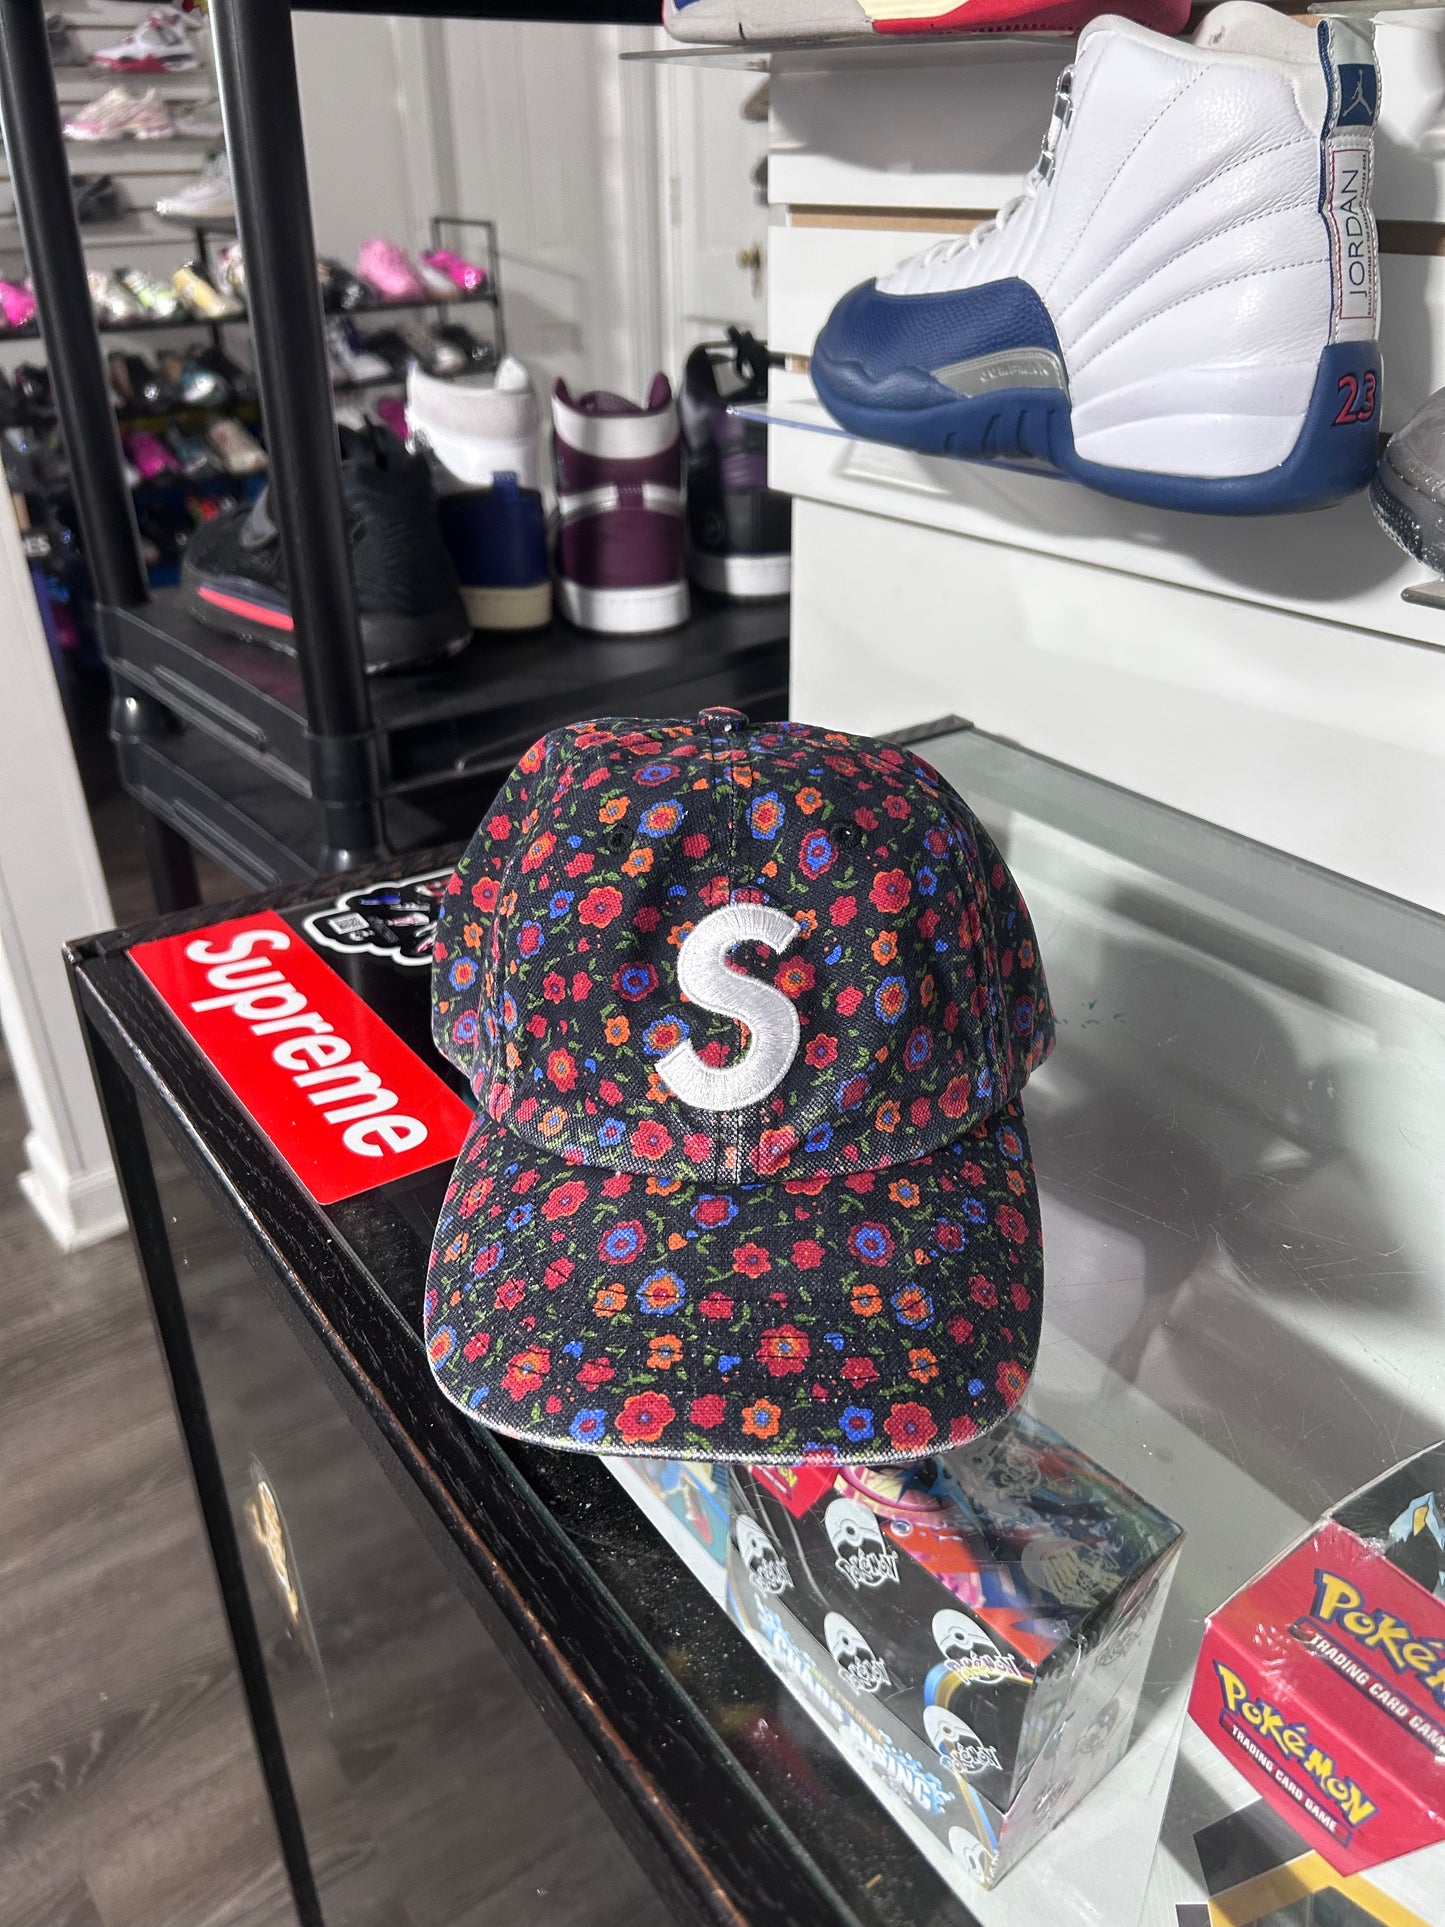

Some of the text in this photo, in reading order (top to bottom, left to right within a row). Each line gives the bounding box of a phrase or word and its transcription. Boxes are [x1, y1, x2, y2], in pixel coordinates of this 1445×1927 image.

[1340, 170, 1368, 298] JORDAN
[1332, 370, 1376, 426] 23
[187, 929, 428, 1157] Supreme
[654, 903, 801, 1111] S
[1309, 1632, 1445, 1750] TRADING CARD GAM
[1231, 1724, 1338, 1833] TRADING CARD GAME
